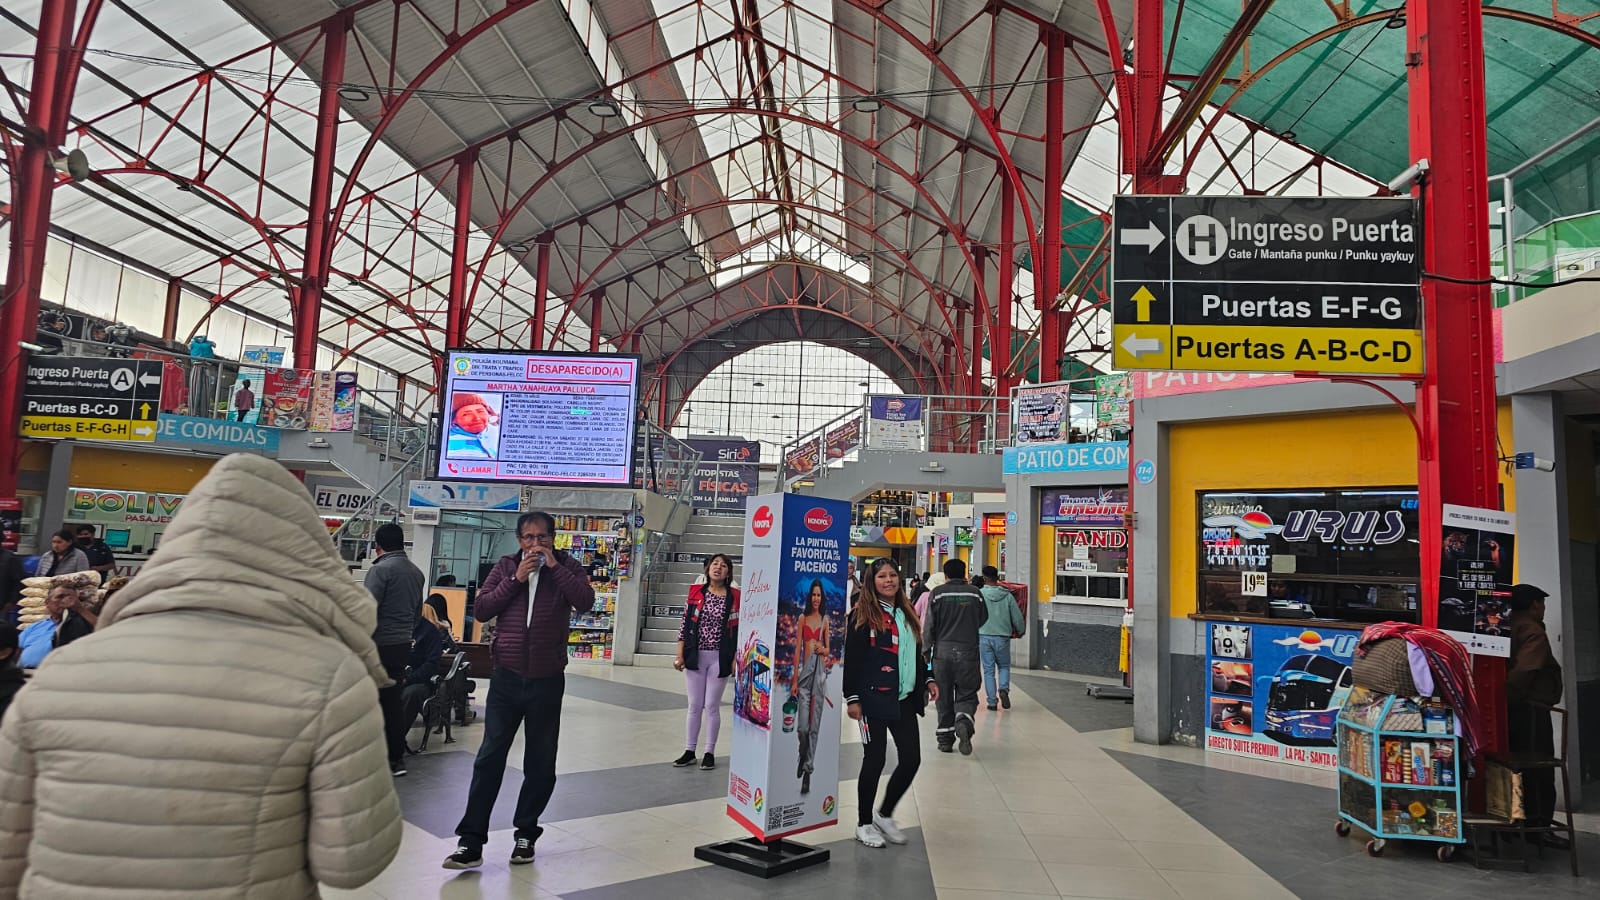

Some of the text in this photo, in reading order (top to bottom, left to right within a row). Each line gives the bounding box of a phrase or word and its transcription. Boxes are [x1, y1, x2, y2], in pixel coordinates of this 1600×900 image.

[1230, 217, 1414, 246] Ingreso Puerta
[1188, 223, 1217, 257] H
[1228, 248, 1252, 259] Gate
[1261, 249, 1303, 259] Mantaña
[1305, 250, 1338, 261] punku
[1346, 250, 1378, 260] Punku
[1381, 251, 1414, 264] yaykuy
[1202, 295, 1402, 320] Puertas E-F-G
[1176, 336, 1411, 363] Puertas A-B-C-D
[28, 365, 109, 380] Ingreso Puerta
[531, 364, 623, 377] DESAPARECIDO(A)
[115, 371, 129, 386] A
[487, 383, 517, 392] MARTHA
[28, 401, 119, 415] Puertas B-C-D
[22, 420, 127, 434] Puertas E-F-G-H
[181, 421, 267, 445] COMIDAS
[718, 448, 745, 460] Sirio
[1017, 446, 1128, 468] PATIO DE COM
[462, 466, 491, 474] LLAMAR
[316, 492, 373, 508] EL CISN
[1282, 510, 1405, 544] URUS
[795, 537, 838, 549] LA PINTURA
[792, 547, 833, 560] FAVORITA
[794, 559, 838, 573] PACEÑOS
[1208, 735, 1231, 750] DIRECTO
[1232, 739, 1250, 753] SUITE
[1251, 741, 1279, 757] PREMIUM
[1285, 748, 1292, 759] LA
[1293, 749, 1305, 761] PAZ
[1310, 751, 1331, 765] SANTA
